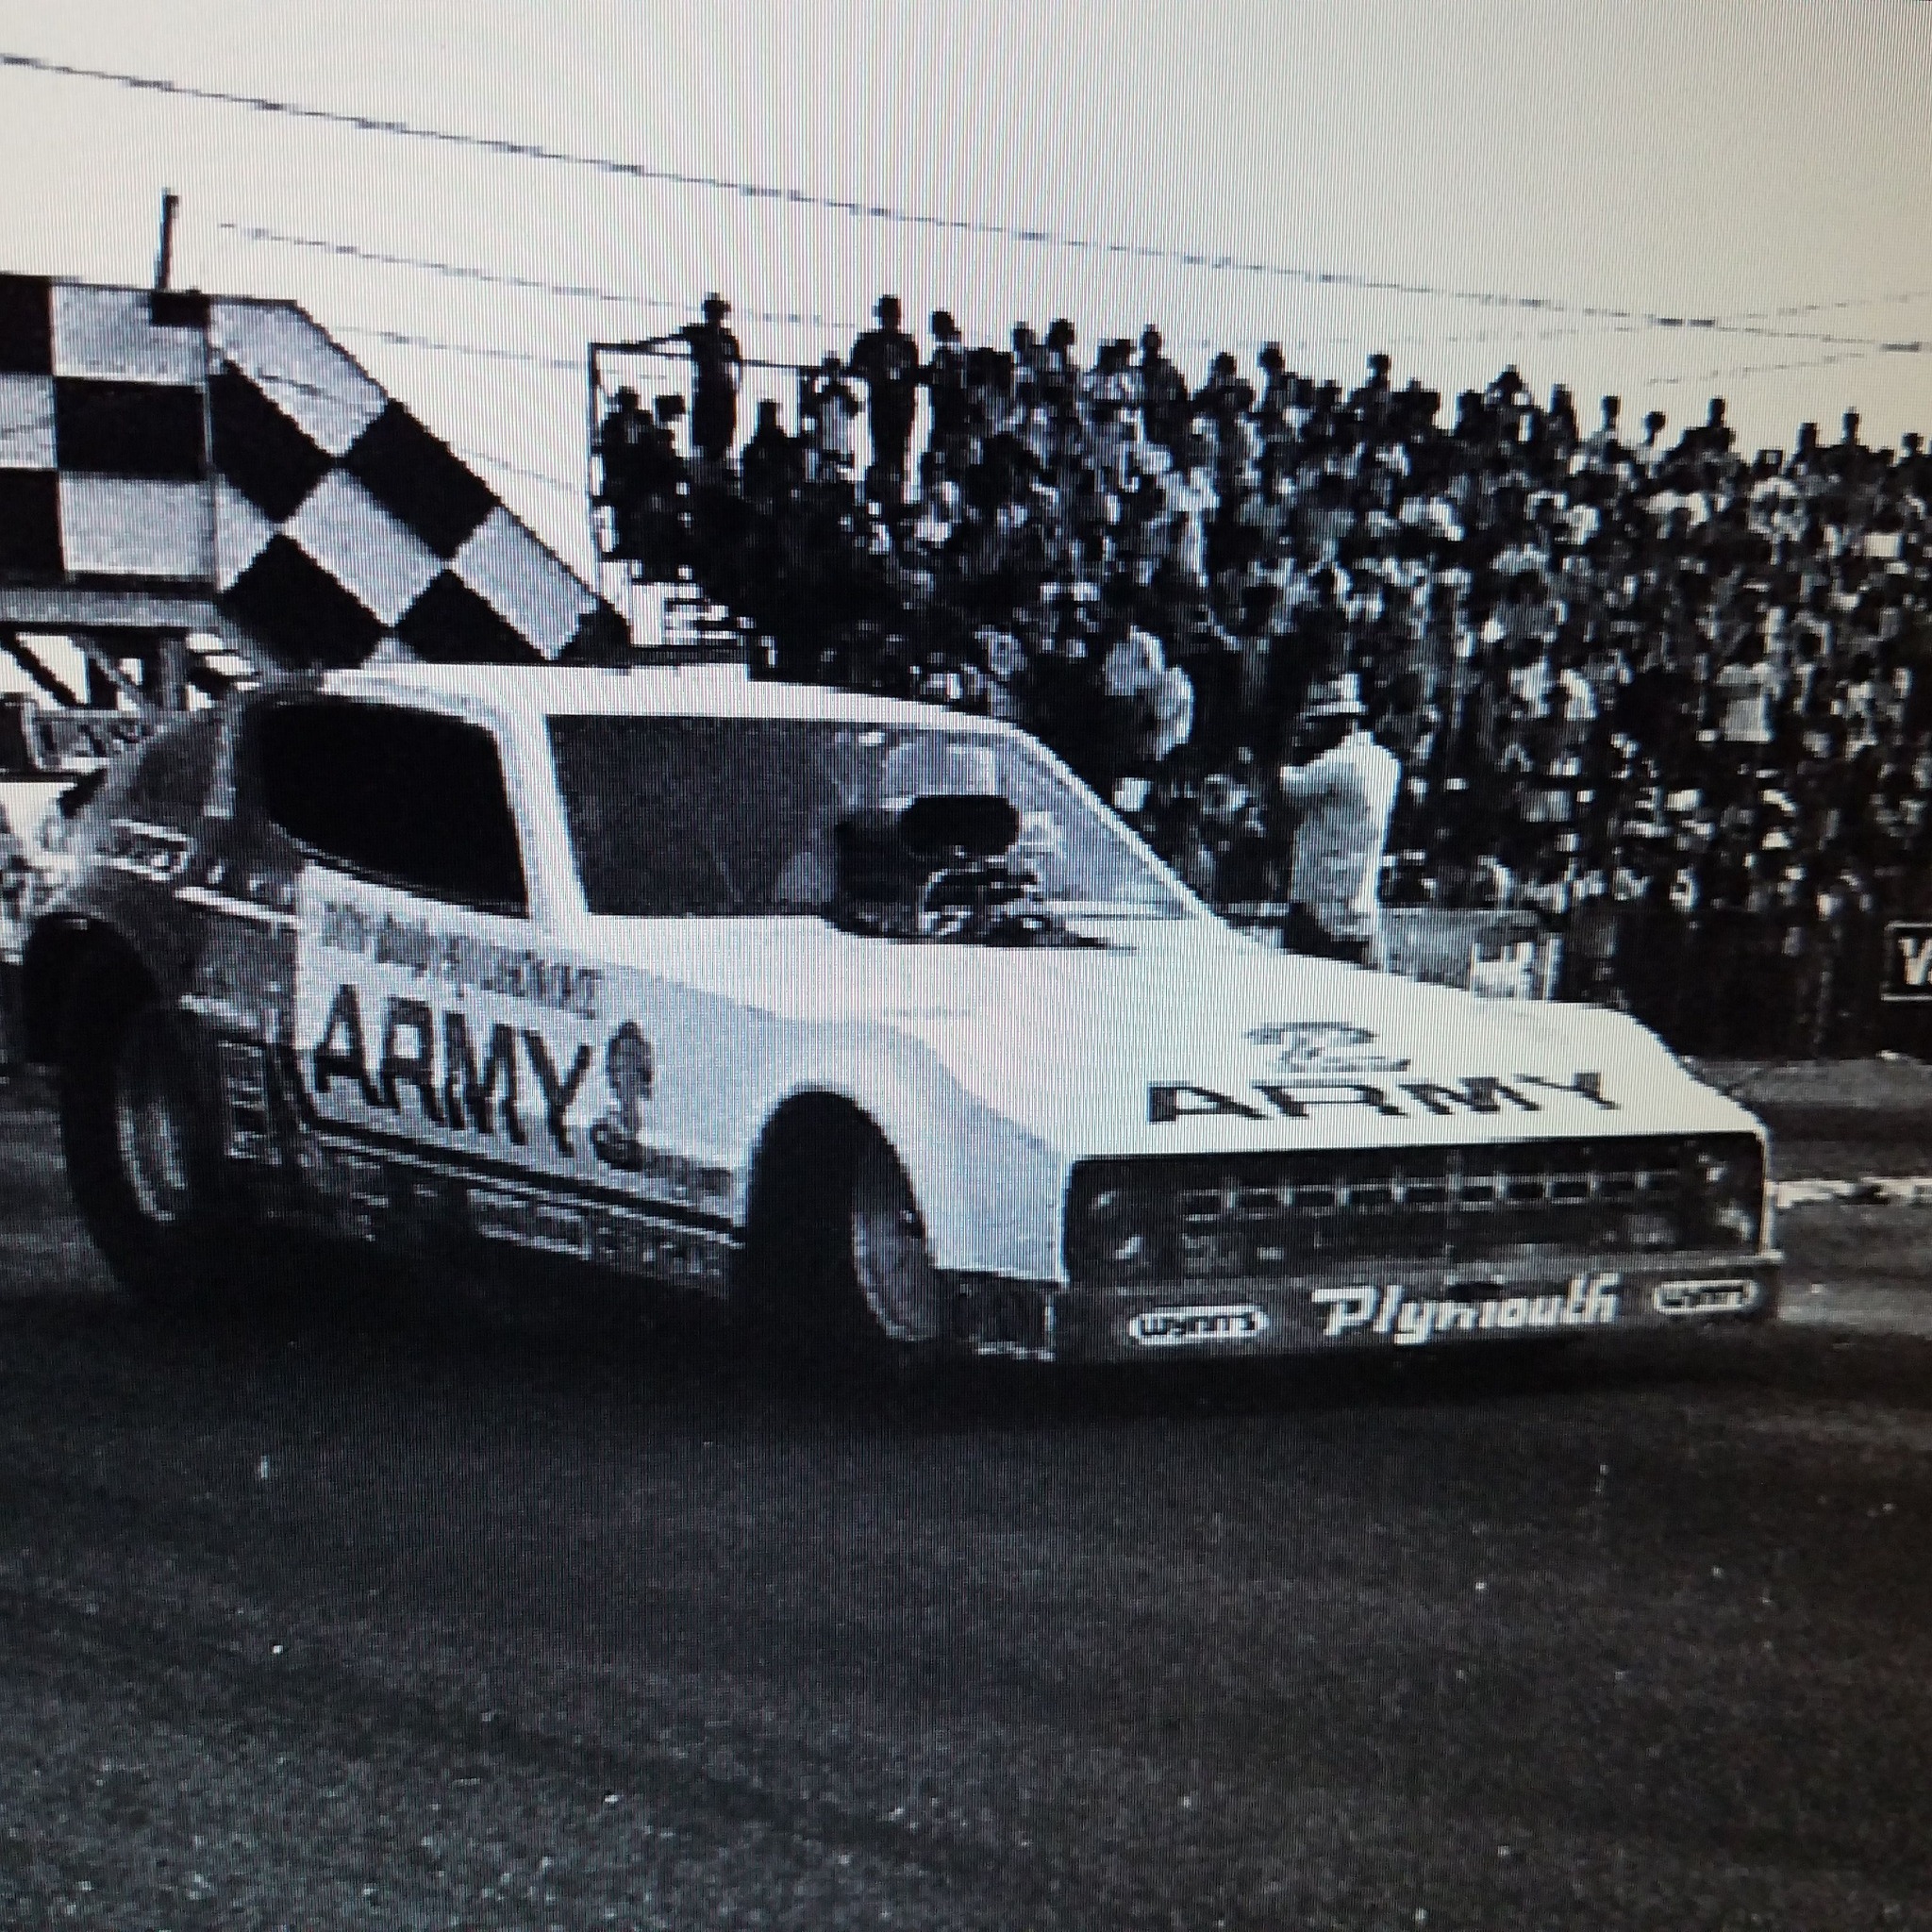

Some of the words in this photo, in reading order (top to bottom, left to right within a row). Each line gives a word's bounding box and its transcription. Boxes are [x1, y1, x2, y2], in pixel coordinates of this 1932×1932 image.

[315, 983, 592, 1158] ARMY
[1147, 1072, 1623, 1125] ARMY
[1311, 1272, 1621, 1347] Plymouth
